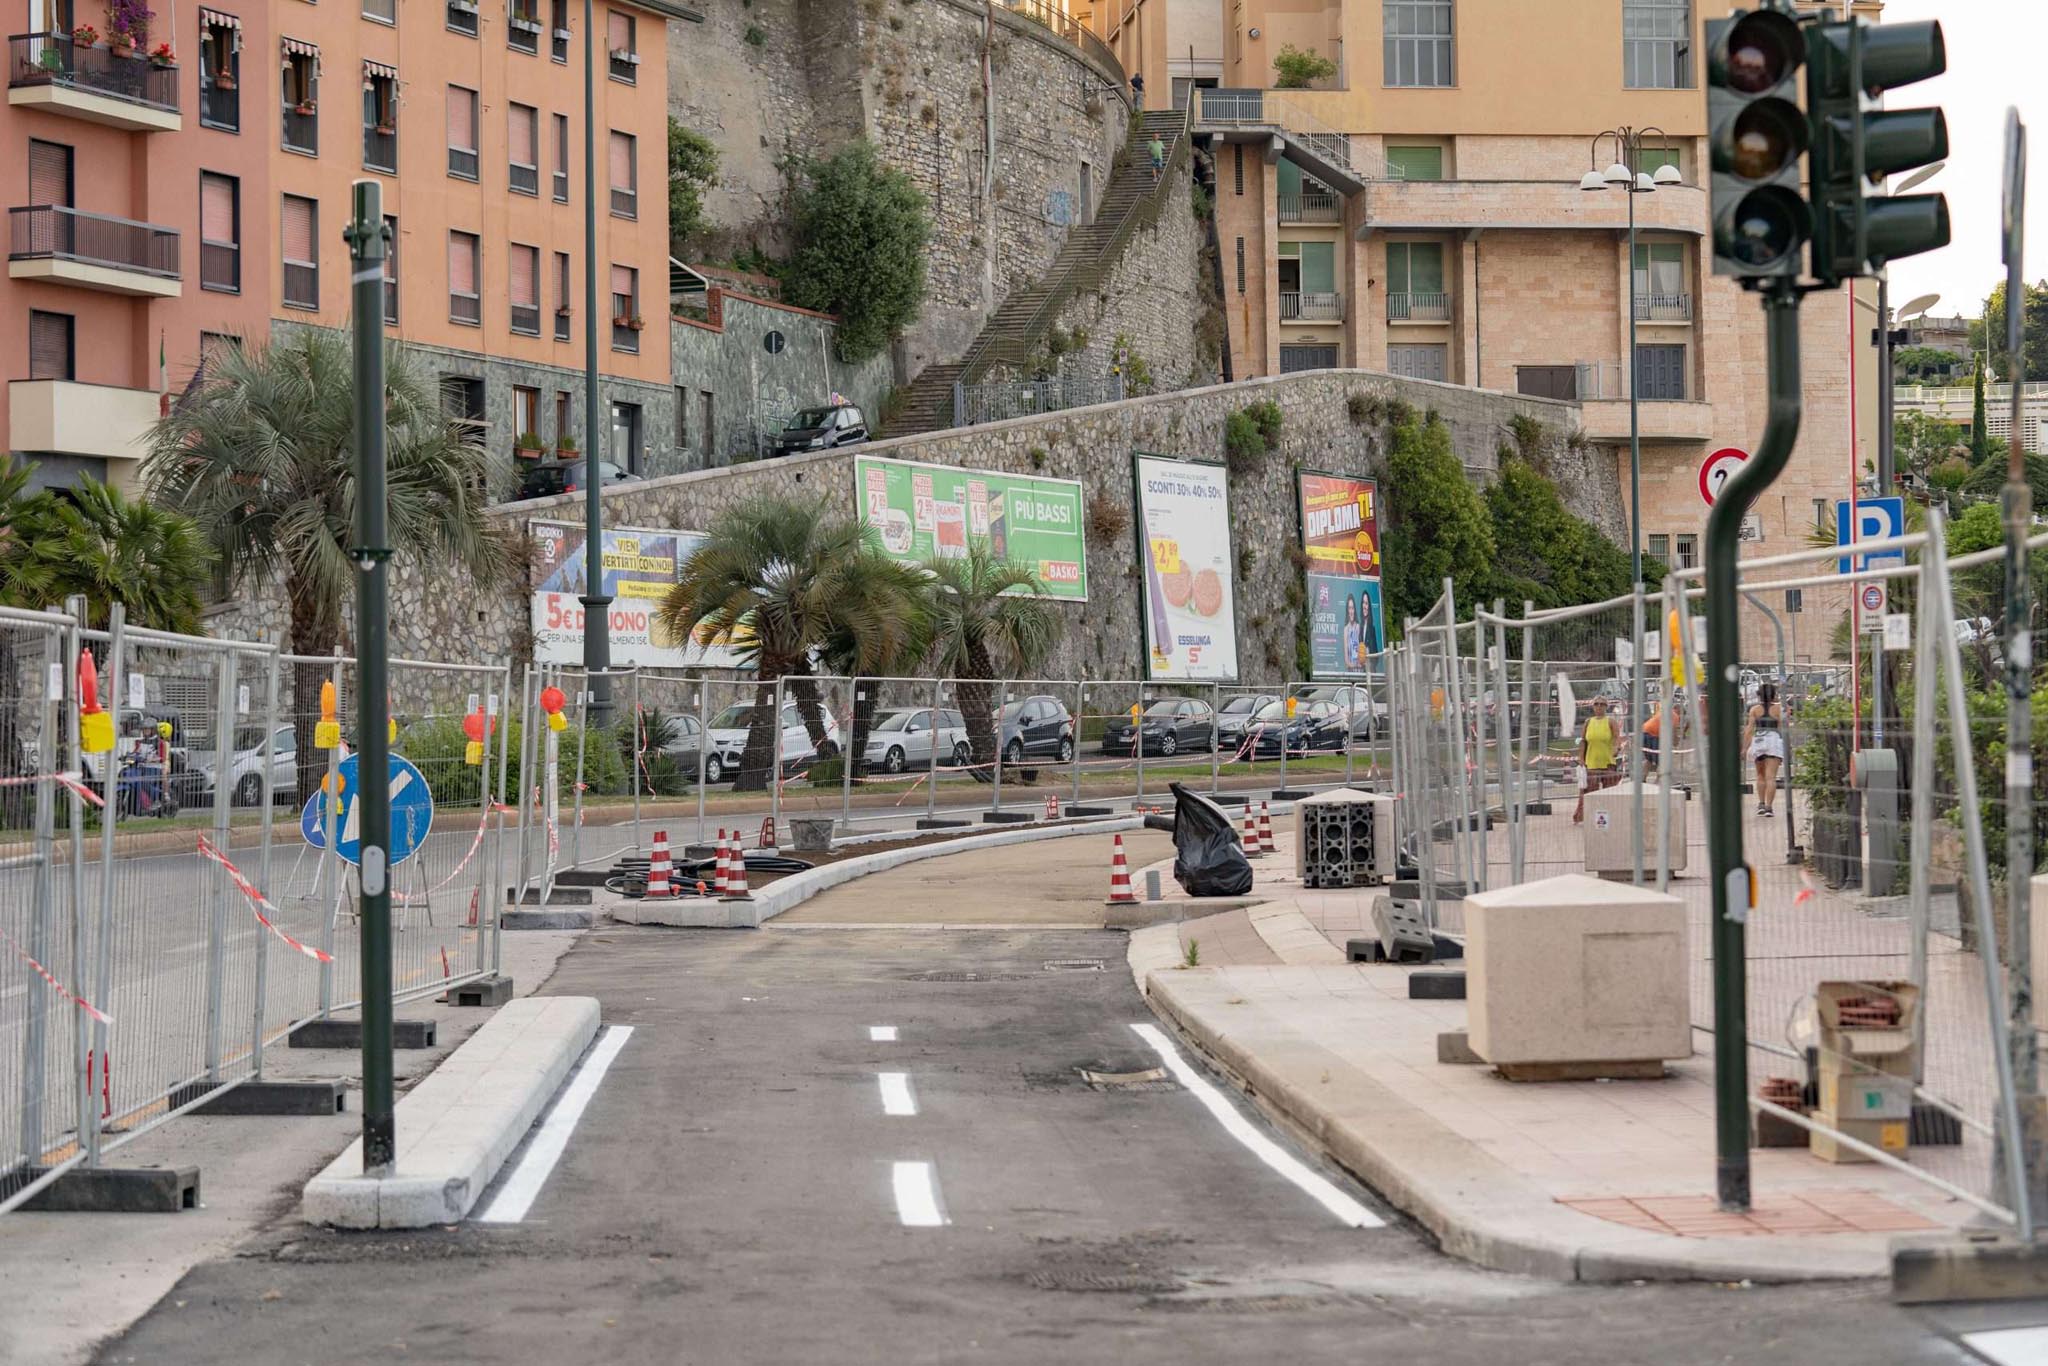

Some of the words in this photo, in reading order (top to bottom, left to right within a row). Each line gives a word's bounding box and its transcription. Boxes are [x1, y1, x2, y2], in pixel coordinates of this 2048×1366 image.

[1147, 480, 1175, 493] SCONTI
[1177, 484, 1192, 496] 30%
[1192, 486, 1207, 498] 40%
[1208, 487, 1222, 499] 50%
[1015, 496, 1034, 520] PIÙ
[1037, 502, 1070, 523] BASSI
[1851, 506, 1891, 569] P
[618, 540, 639, 553] VIENI
[640, 559, 654, 571] CON
[1050, 565, 1078, 579] BASKO
[608, 612, 647, 631] UONO
[547, 633, 560, 641] PER
[562, 634, 576, 643] UNA
[1178, 635, 1211, 646] ESSELUNGA
